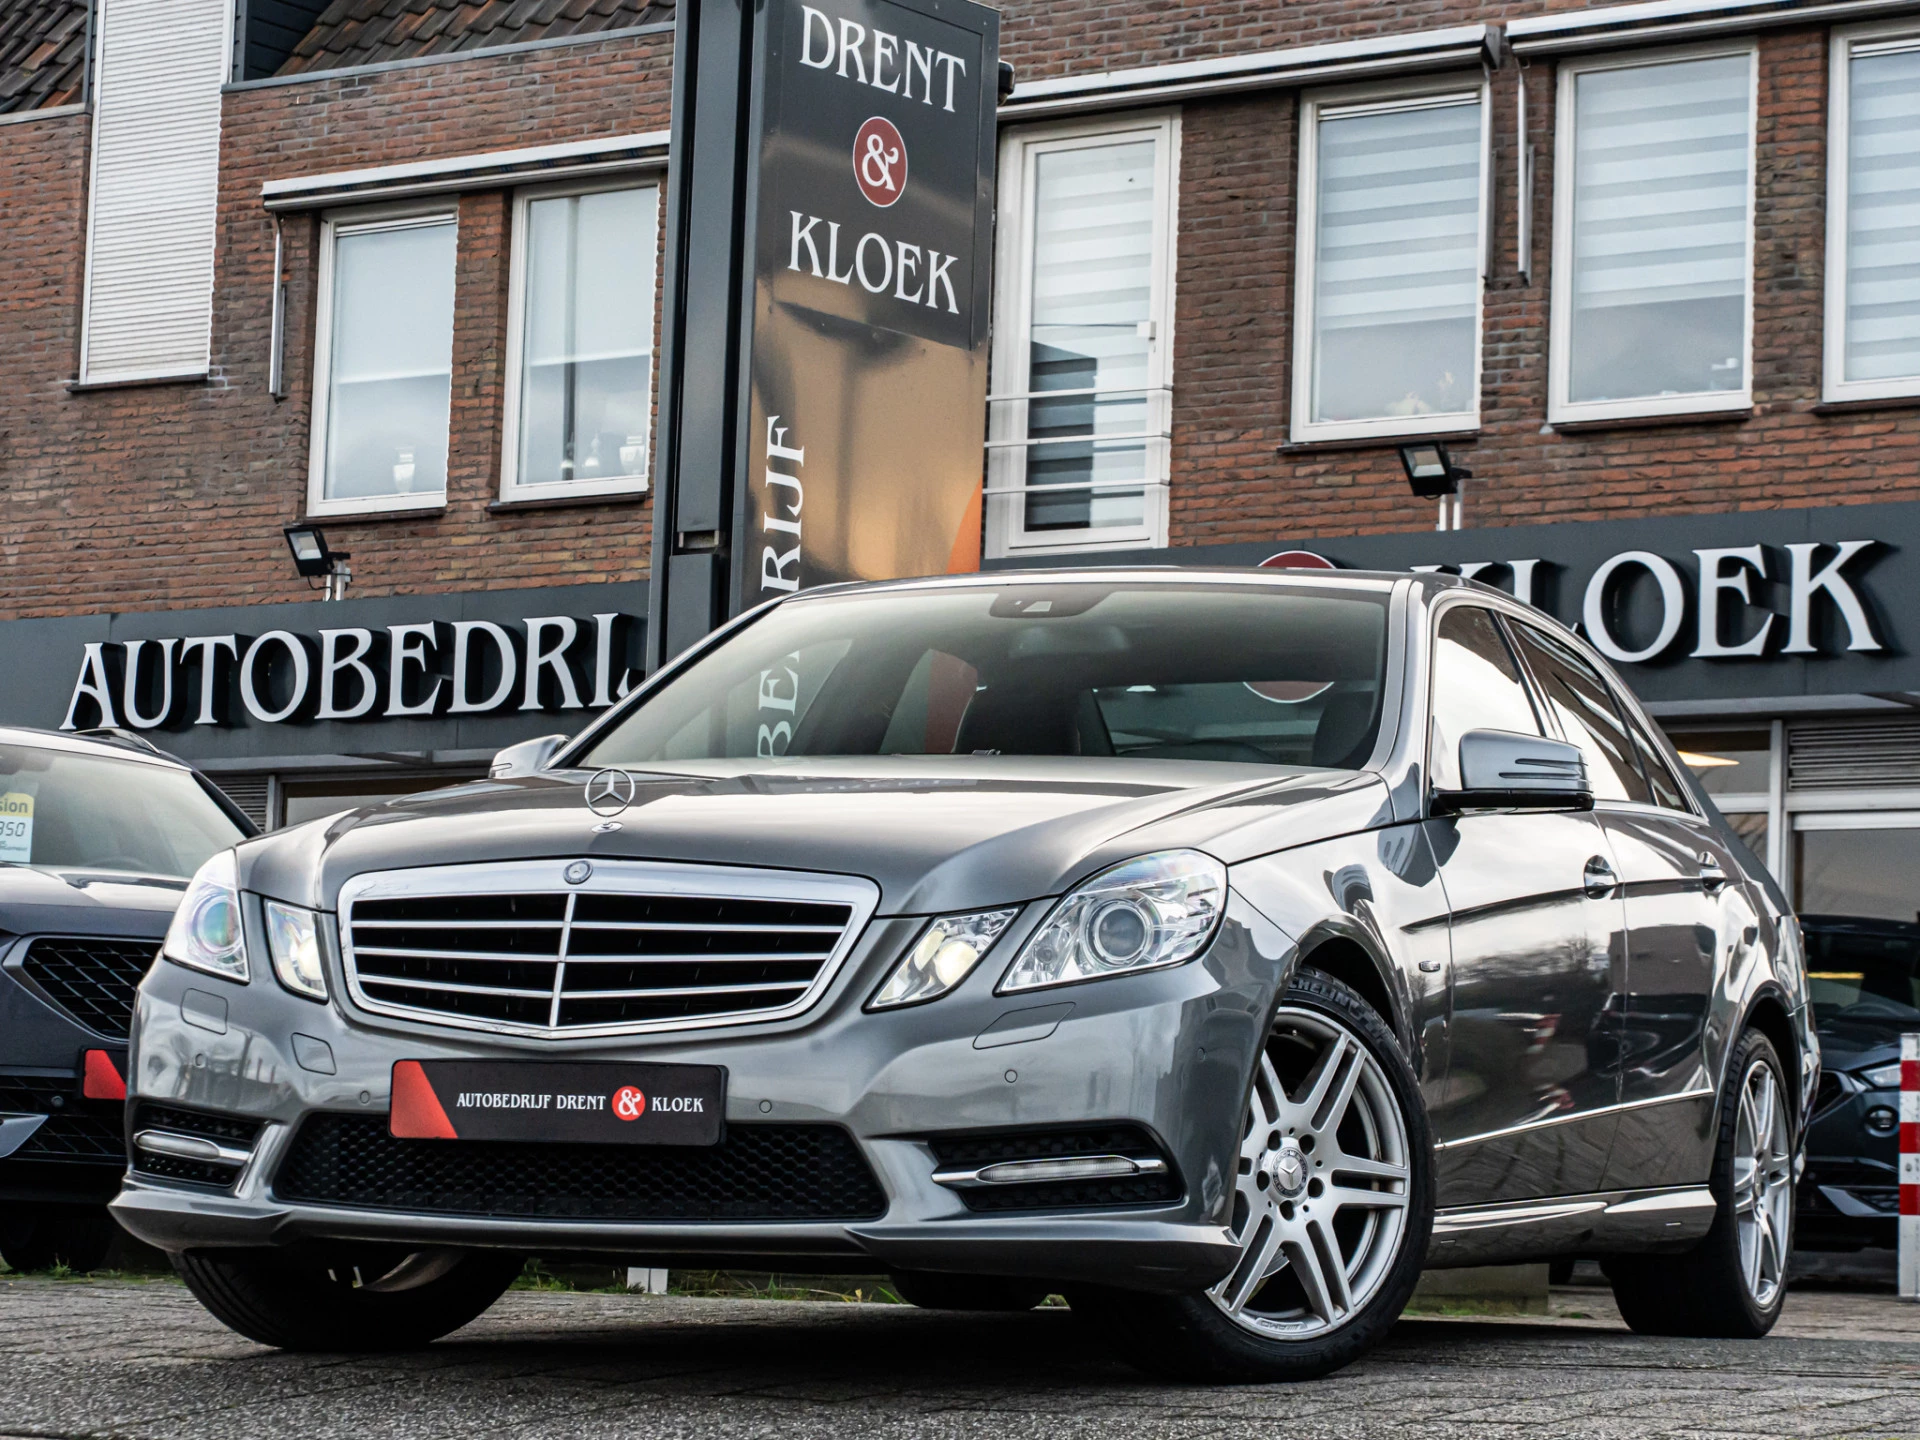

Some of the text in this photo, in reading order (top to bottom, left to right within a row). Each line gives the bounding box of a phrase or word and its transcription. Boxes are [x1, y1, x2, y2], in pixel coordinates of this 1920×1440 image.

[800, 5, 966, 113] DRENT
[862, 133, 899, 191] &
[787, 210, 960, 315] KLOEK
[59, 612, 630, 730] AUTOBEDRI
[456, 1089, 704, 1116] AUTOBEDRIJF DRENT & KLOEK
